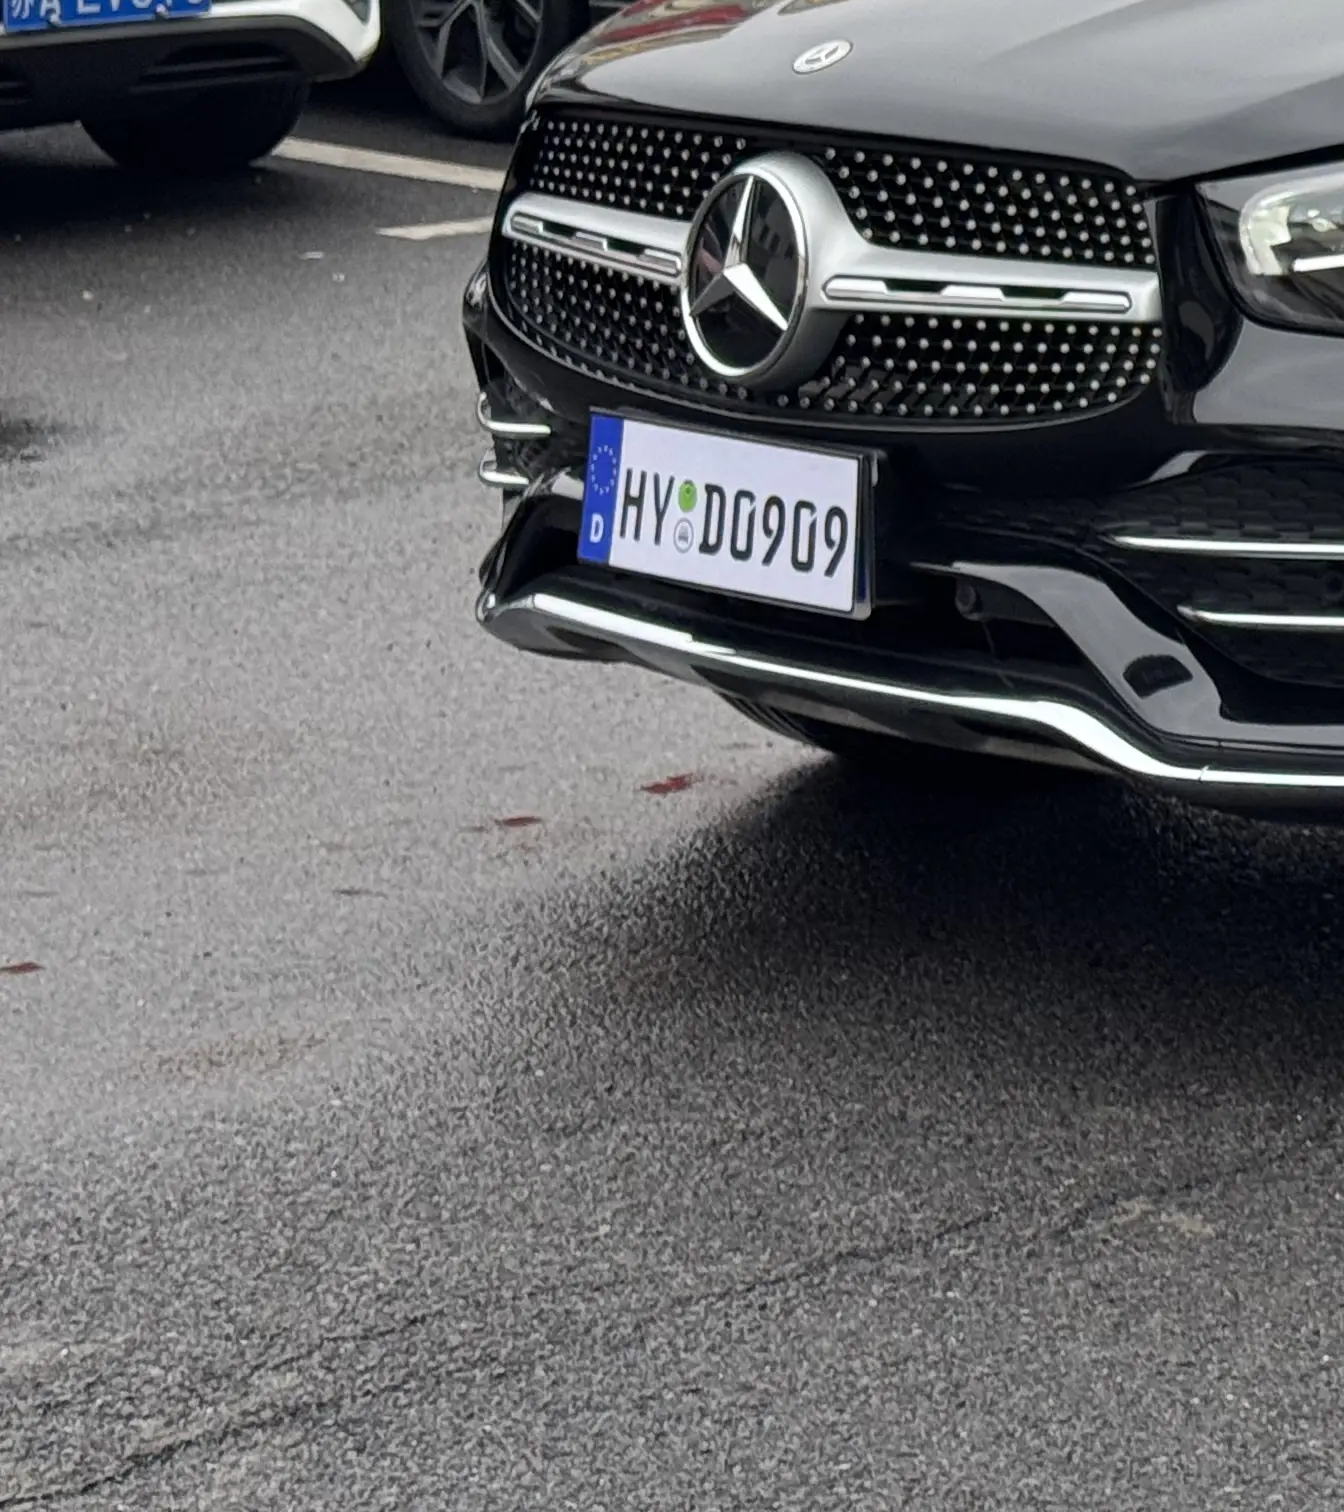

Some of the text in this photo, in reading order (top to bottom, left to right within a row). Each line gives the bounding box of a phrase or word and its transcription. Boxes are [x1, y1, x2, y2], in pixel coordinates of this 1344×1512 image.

[589, 513, 605, 544] D
[619, 467, 849, 578] HY D0909
